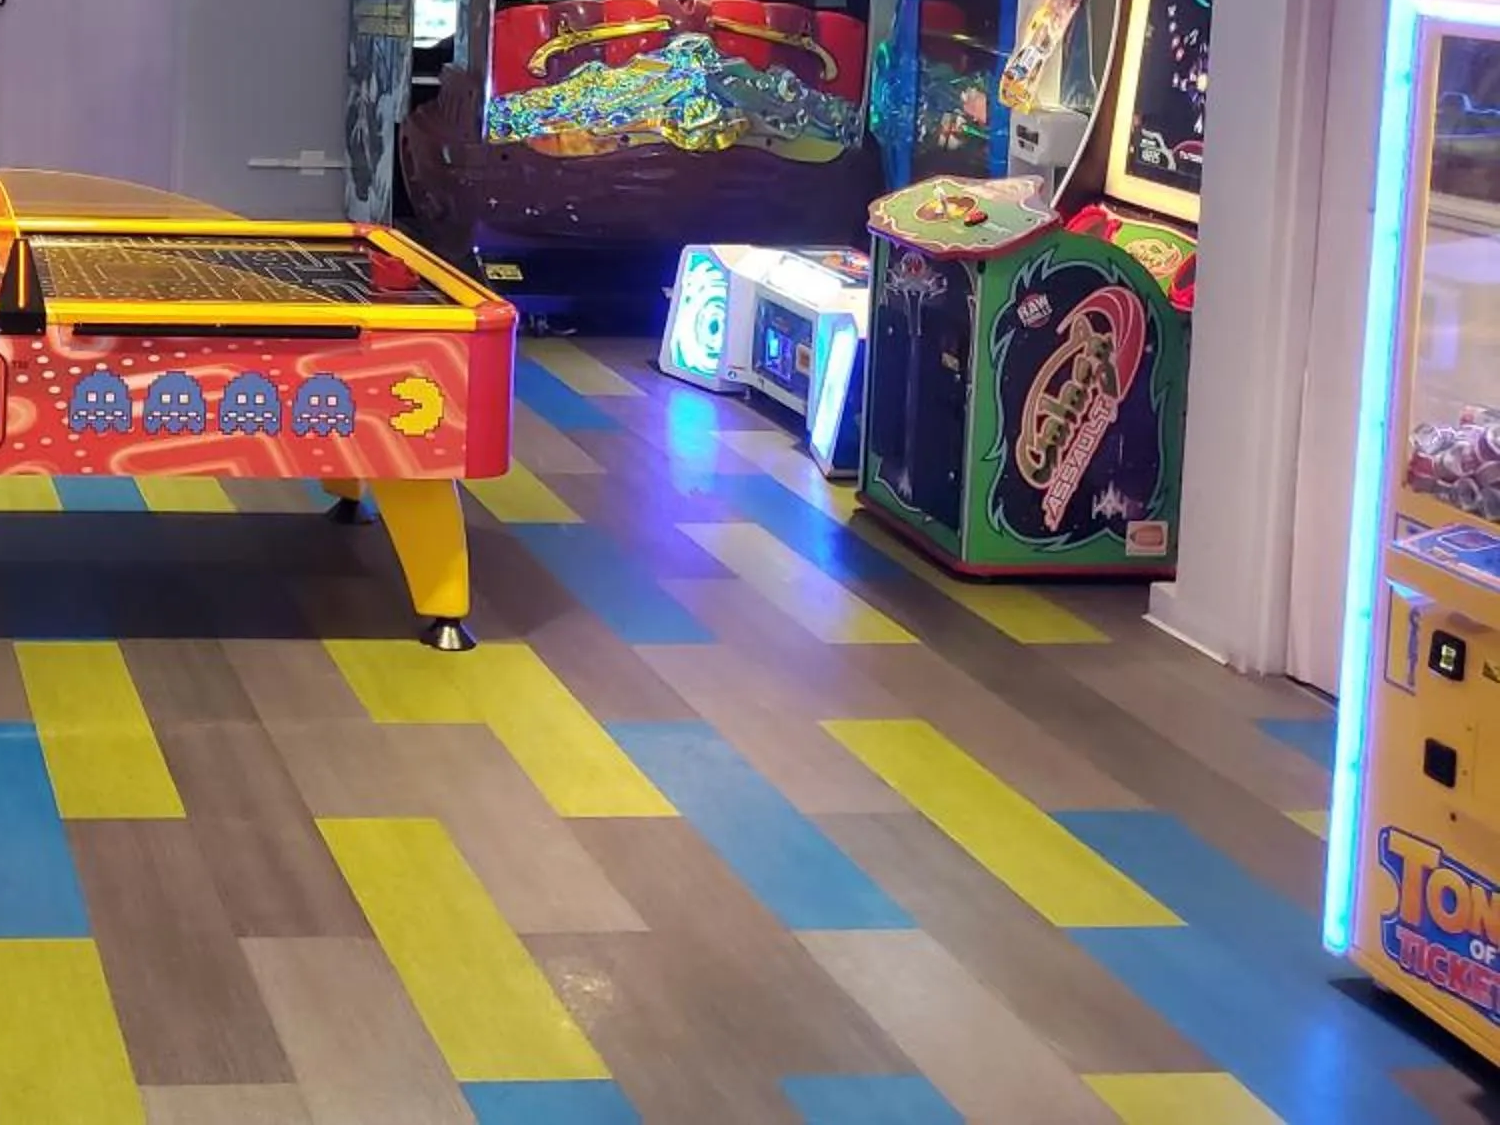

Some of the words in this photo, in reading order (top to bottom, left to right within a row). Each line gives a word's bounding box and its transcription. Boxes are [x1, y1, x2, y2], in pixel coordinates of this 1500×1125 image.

[1043, 394, 1119, 532] ASSAULT
[1388, 830, 1500, 948] TON
[1469, 939, 1497, 965] OF
